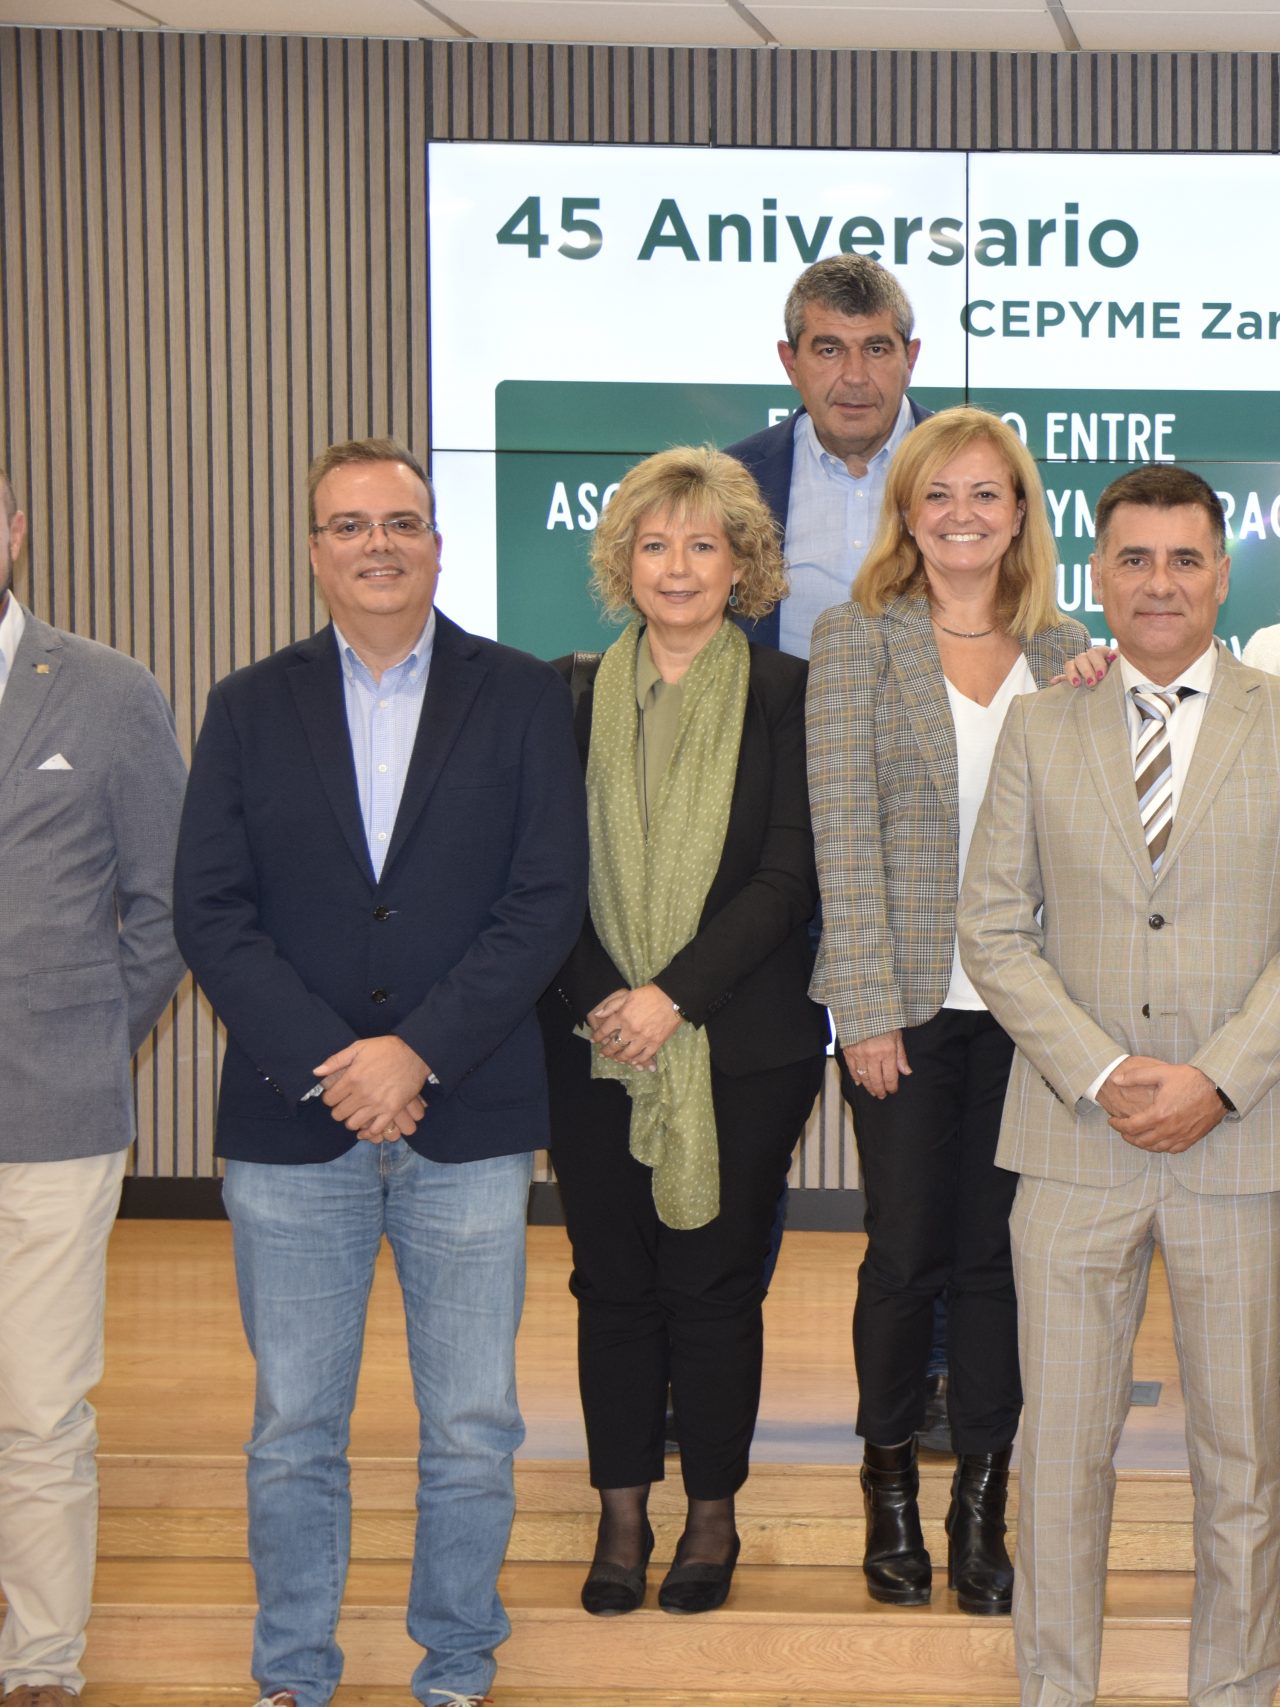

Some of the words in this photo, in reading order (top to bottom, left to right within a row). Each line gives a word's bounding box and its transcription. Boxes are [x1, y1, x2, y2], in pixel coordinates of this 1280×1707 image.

[495, 195, 604, 262] 45
[636, 197, 1140, 269] Aniversario
[960, 299, 1182, 339] CEPYME
[1046, 412, 1176, 465] ENTRE
